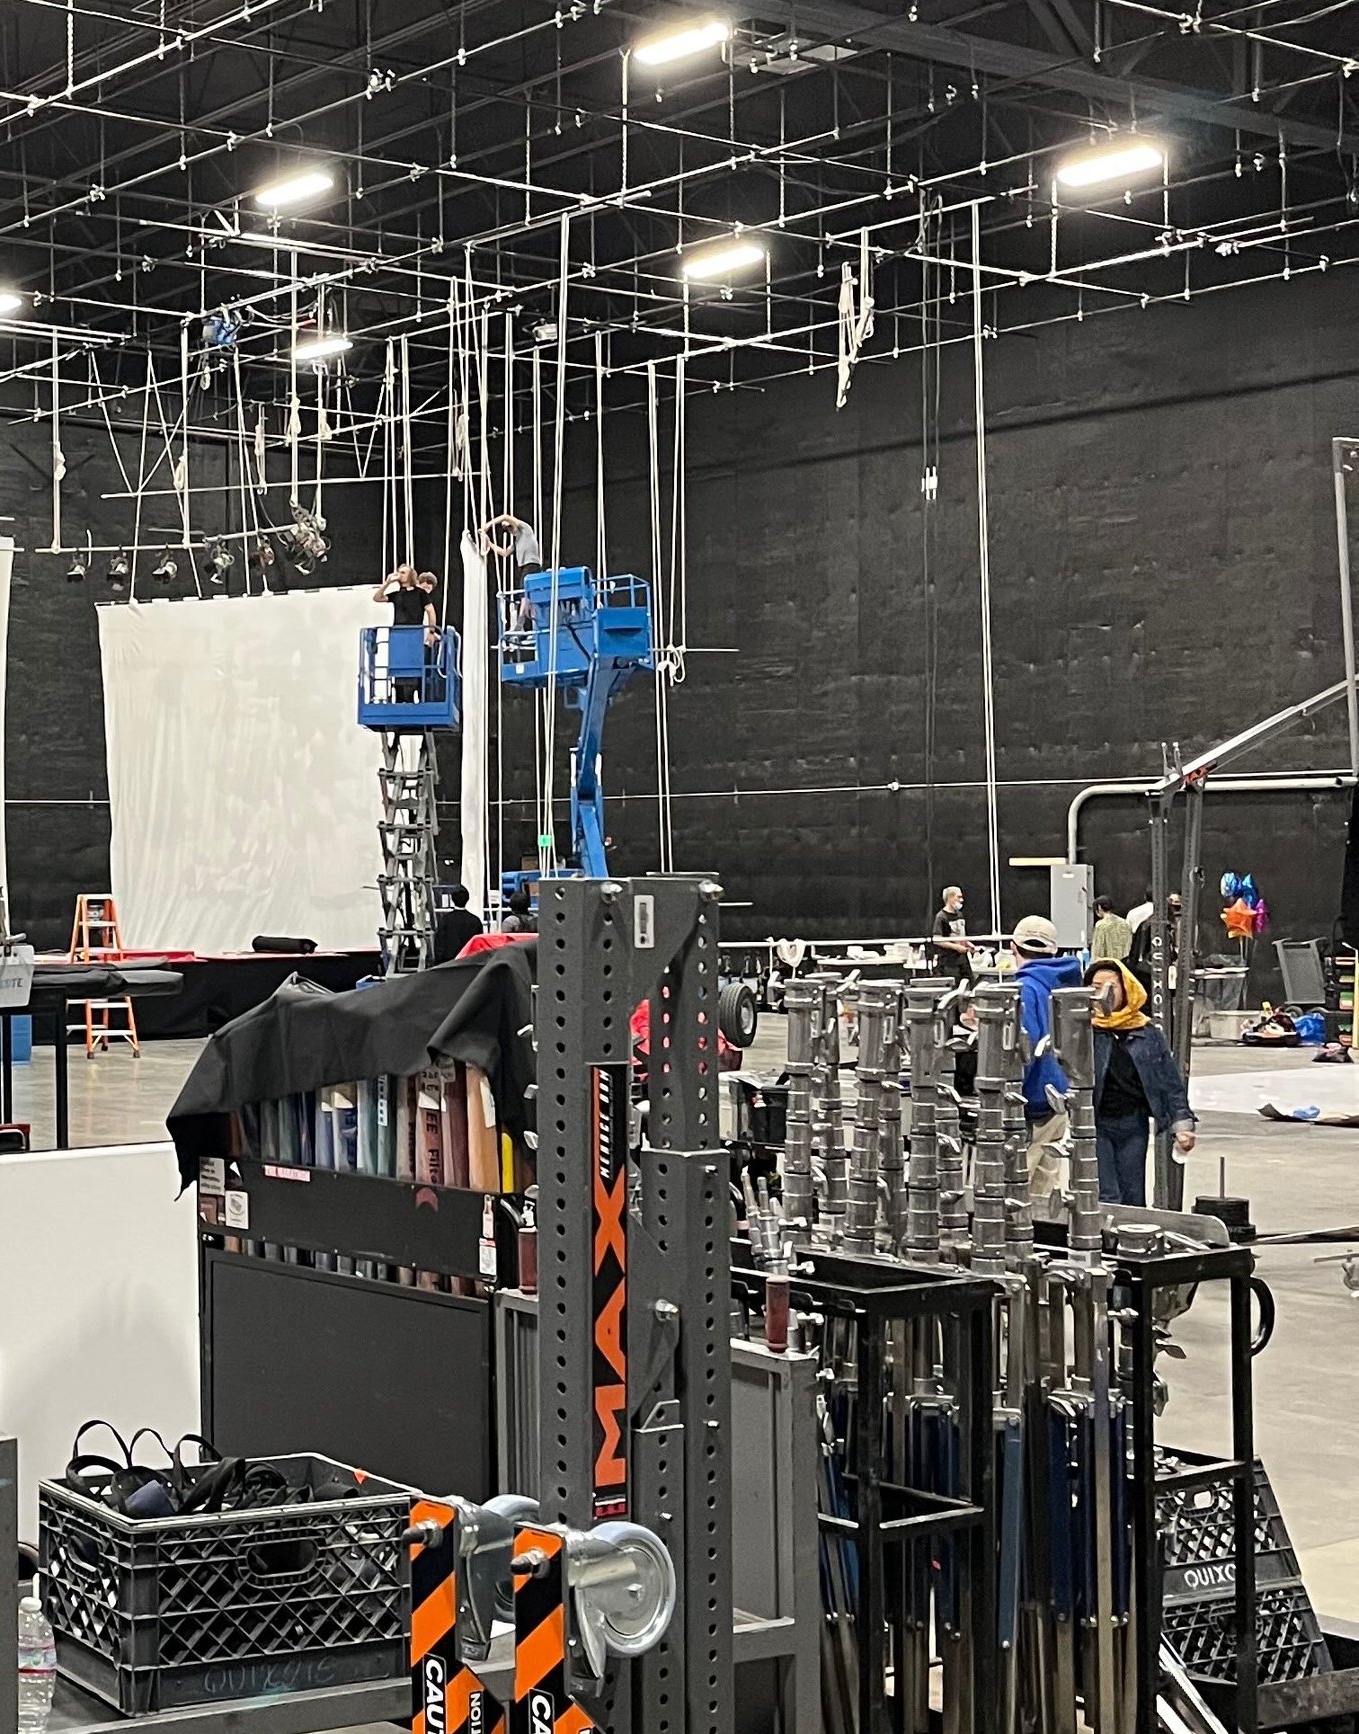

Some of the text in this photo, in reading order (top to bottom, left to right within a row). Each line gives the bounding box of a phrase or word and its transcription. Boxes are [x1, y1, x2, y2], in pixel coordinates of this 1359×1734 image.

[426, 1110, 440, 1184] EE Filte
[593, 1163, 627, 1487] MAX
[1184, 1563, 1236, 1590] QUIXO
